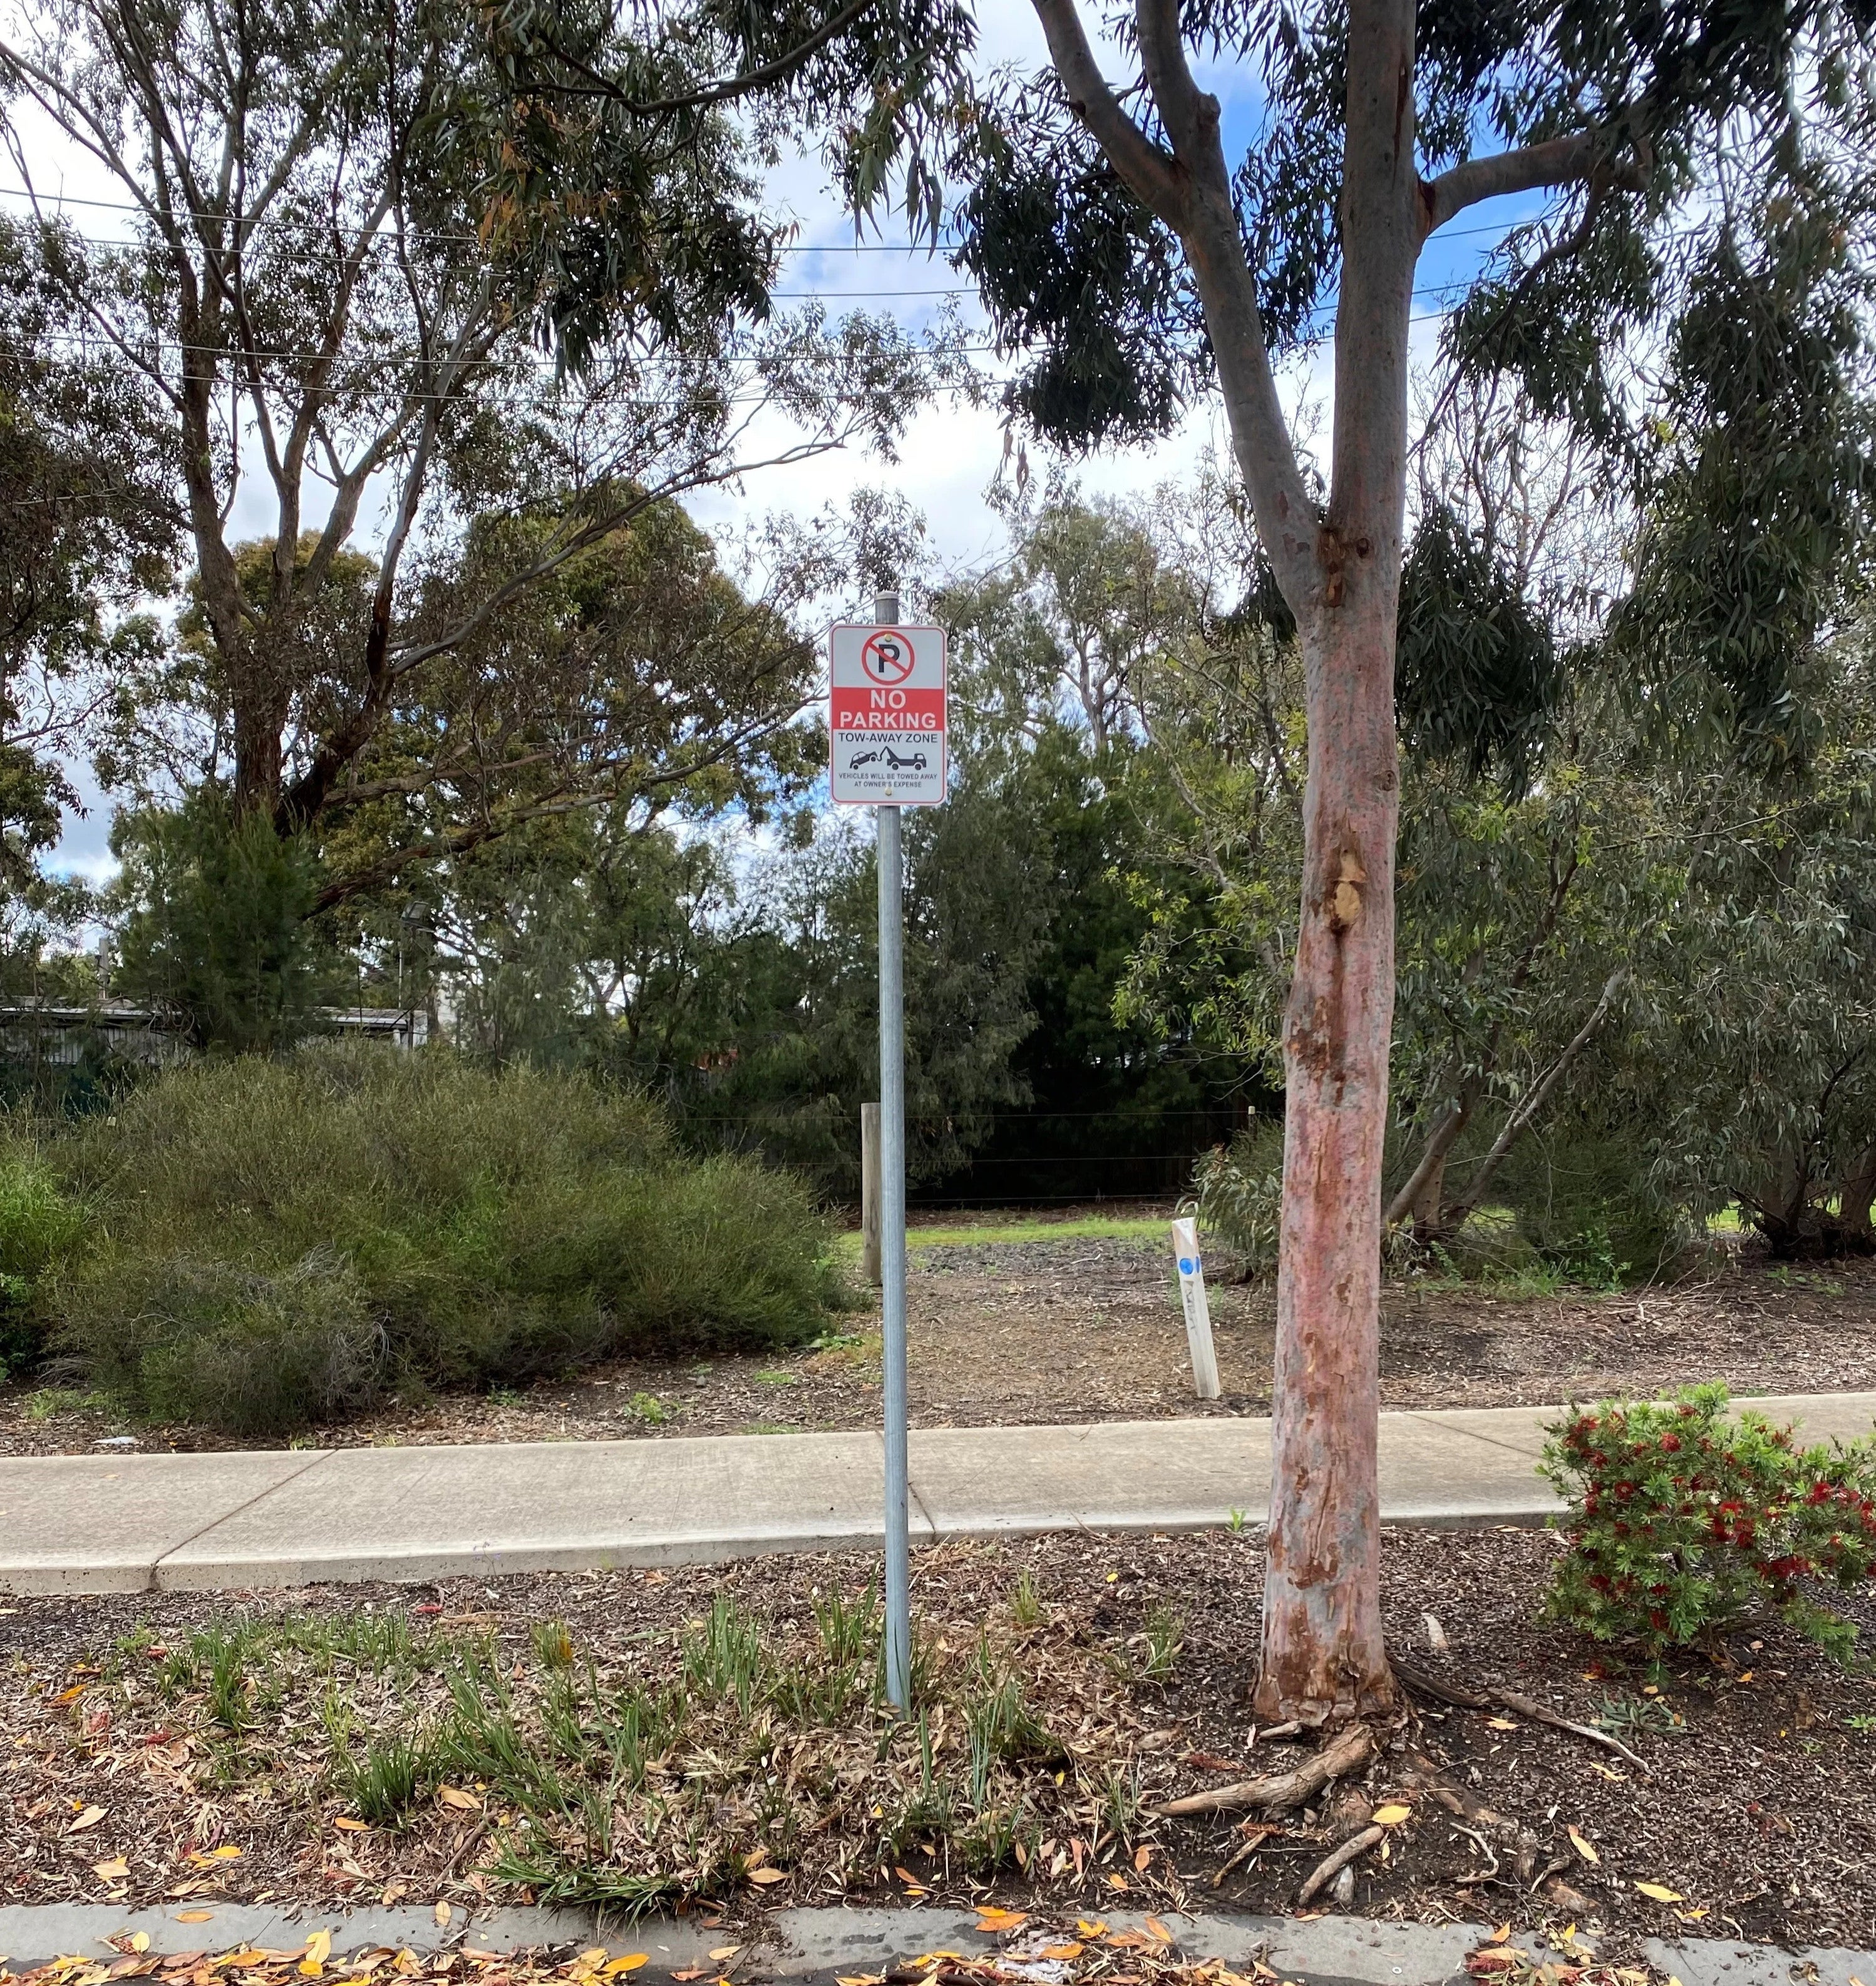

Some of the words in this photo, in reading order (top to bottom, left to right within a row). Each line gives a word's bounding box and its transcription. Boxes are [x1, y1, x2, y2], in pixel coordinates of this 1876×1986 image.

[879, 644, 900, 673] P
[870, 690, 906, 709] NO
[840, 711, 936, 729] PARKING
[838, 733, 902, 743] TOW-AWAY
[905, 733, 938, 743] ZONE
